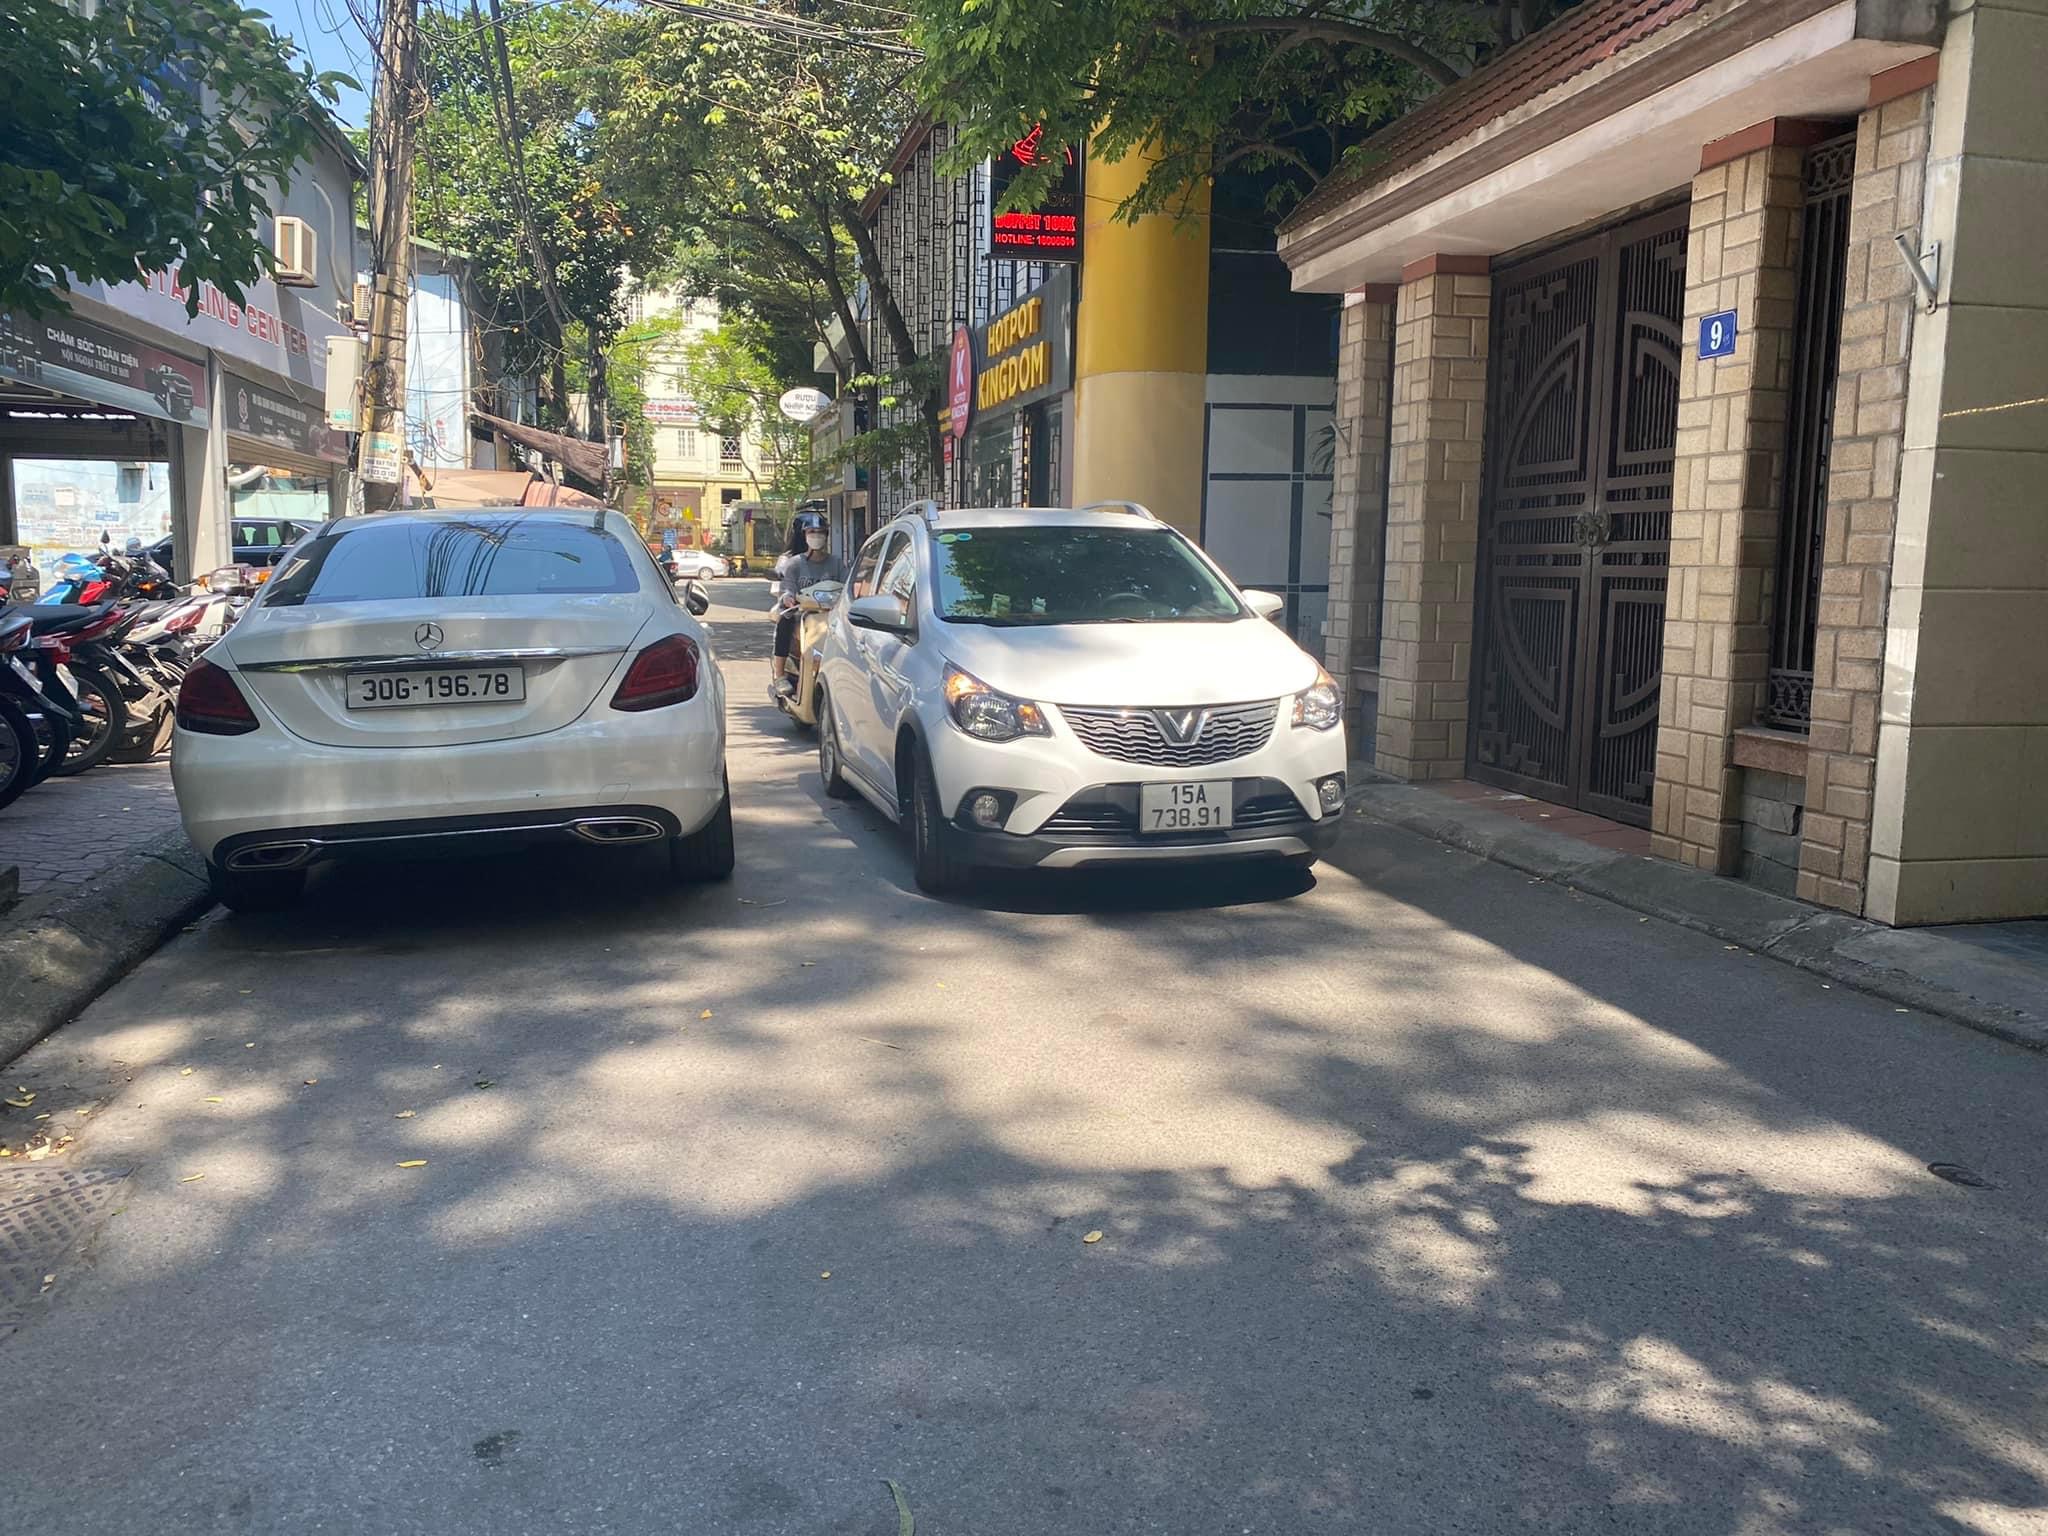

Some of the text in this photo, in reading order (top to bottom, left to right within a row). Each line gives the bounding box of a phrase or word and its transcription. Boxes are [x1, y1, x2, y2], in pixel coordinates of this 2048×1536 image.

[245, 303, 308, 355] CENTER
[986, 297, 1041, 358] HOTPOT
[1710, 320, 1723, 350] 9
[76, 336, 95, 354] SÓC
[977, 340, 1048, 411] KINGDOM
[362, 673, 509, 702] 30G-196.78
[1171, 784, 1207, 805] 15A
[1152, 806, 1221, 828] 738.91
